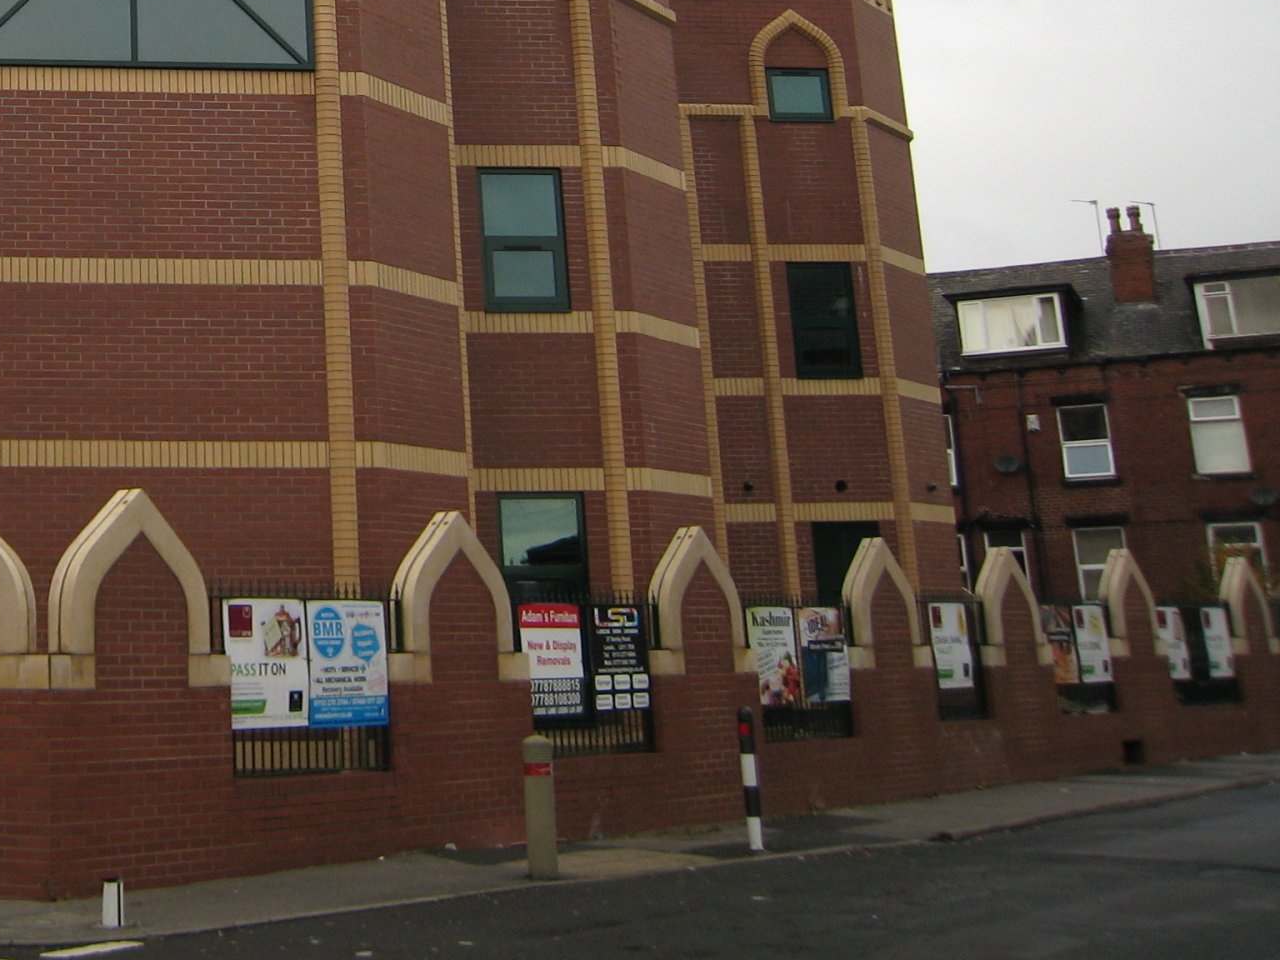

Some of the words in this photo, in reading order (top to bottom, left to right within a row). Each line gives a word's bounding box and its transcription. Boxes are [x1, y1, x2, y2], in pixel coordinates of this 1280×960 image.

[522, 610, 549, 622] Adam's
[550, 610, 578, 623] Furniture
[751, 611, 791, 626] Kashmir
[313, 622, 344, 636] BMR
[527, 640, 543, 650] New
[552, 640, 577, 652] Display
[536, 656, 571, 666] Removals
[231, 663, 257, 676] PASS
[259, 663, 269, 676] IT
[271, 662, 286, 675] ON
